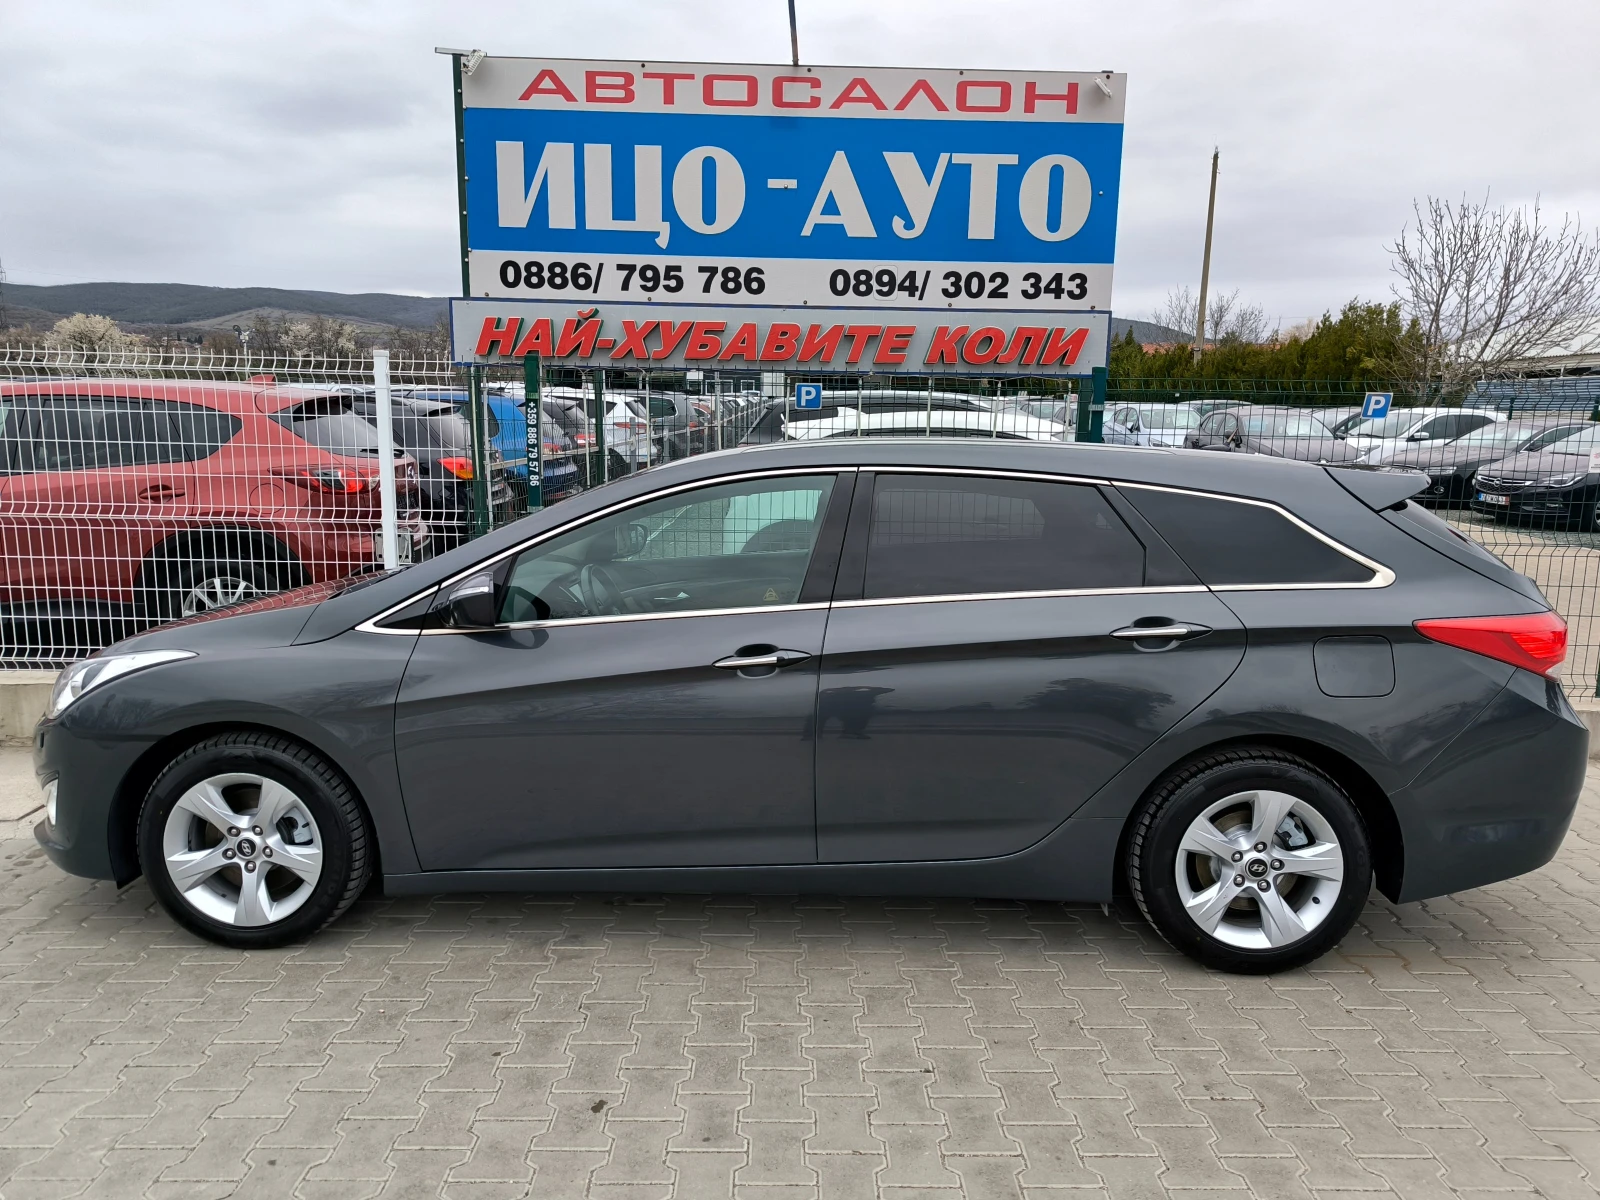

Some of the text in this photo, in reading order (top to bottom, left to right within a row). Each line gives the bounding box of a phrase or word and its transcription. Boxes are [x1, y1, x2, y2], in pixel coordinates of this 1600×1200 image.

[518, 69, 1079, 115] АВТОСАЛОН
[495, 140, 746, 250] ИЦО
[499, 259, 766, 295] 0886/ 795 786
[829, 268, 1088, 301] 0894/ 302 343
[474, 307, 1090, 367] НАЙ-ХУБАВИТЕ КОЛИ
[800, 386, 816, 407] P
[1366, 395, 1386, 416] P
[527, 401, 540, 487] +359 886 79 57 86
